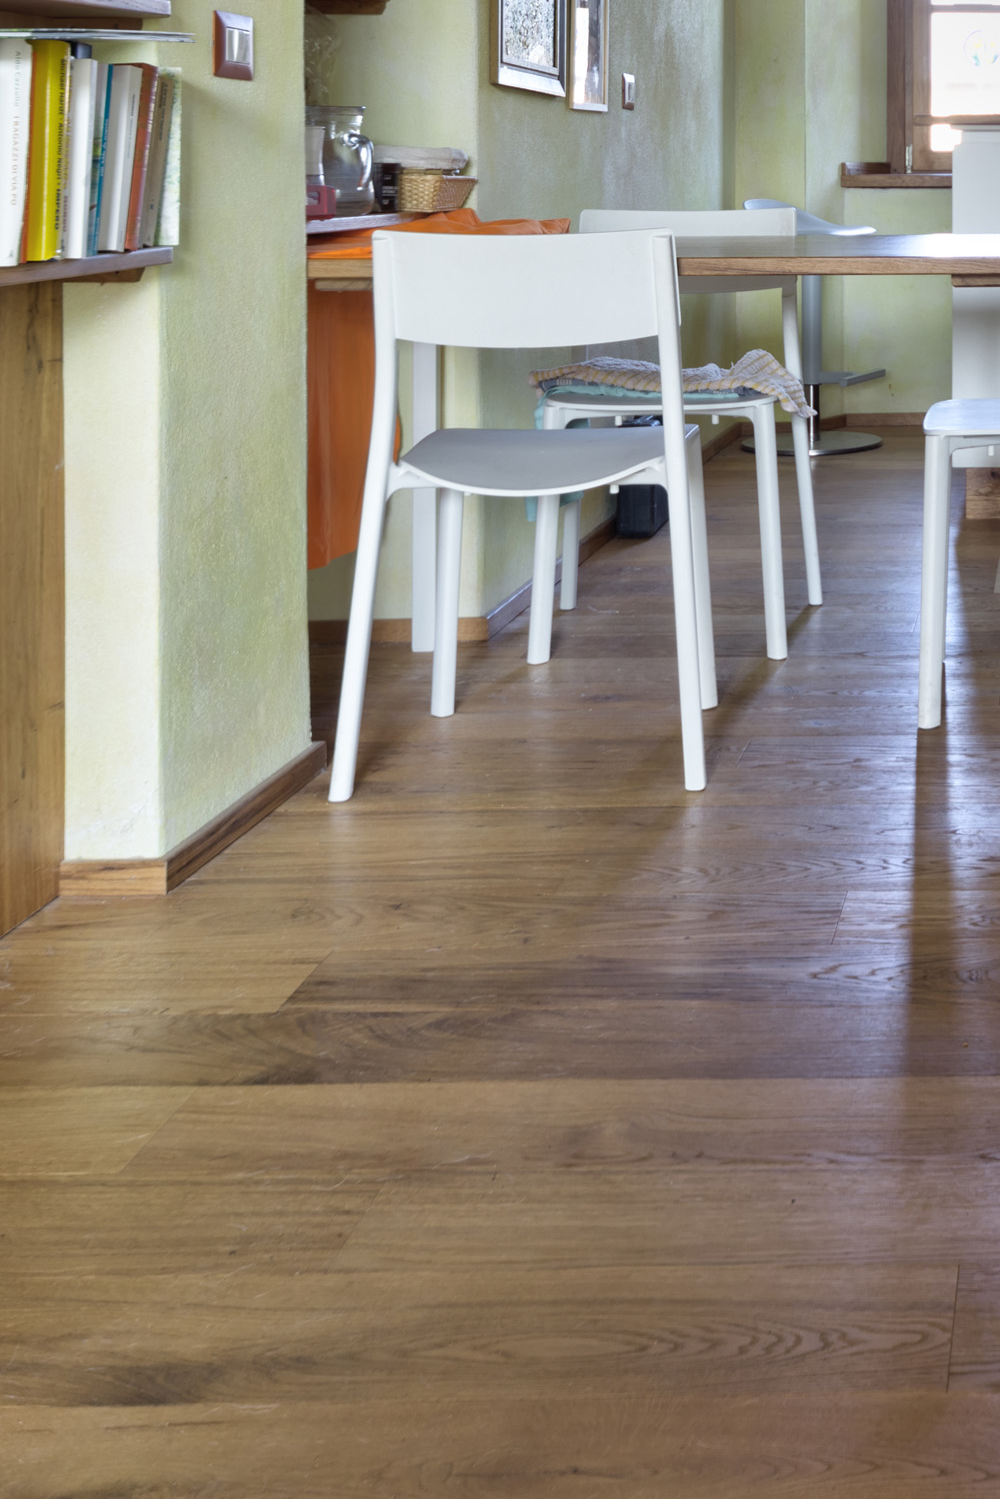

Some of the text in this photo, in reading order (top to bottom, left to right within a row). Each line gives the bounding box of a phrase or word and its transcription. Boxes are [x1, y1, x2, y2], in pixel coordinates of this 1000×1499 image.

[54, 58, 66, 231] Michael Hardt Antonio Negri IMPERO
